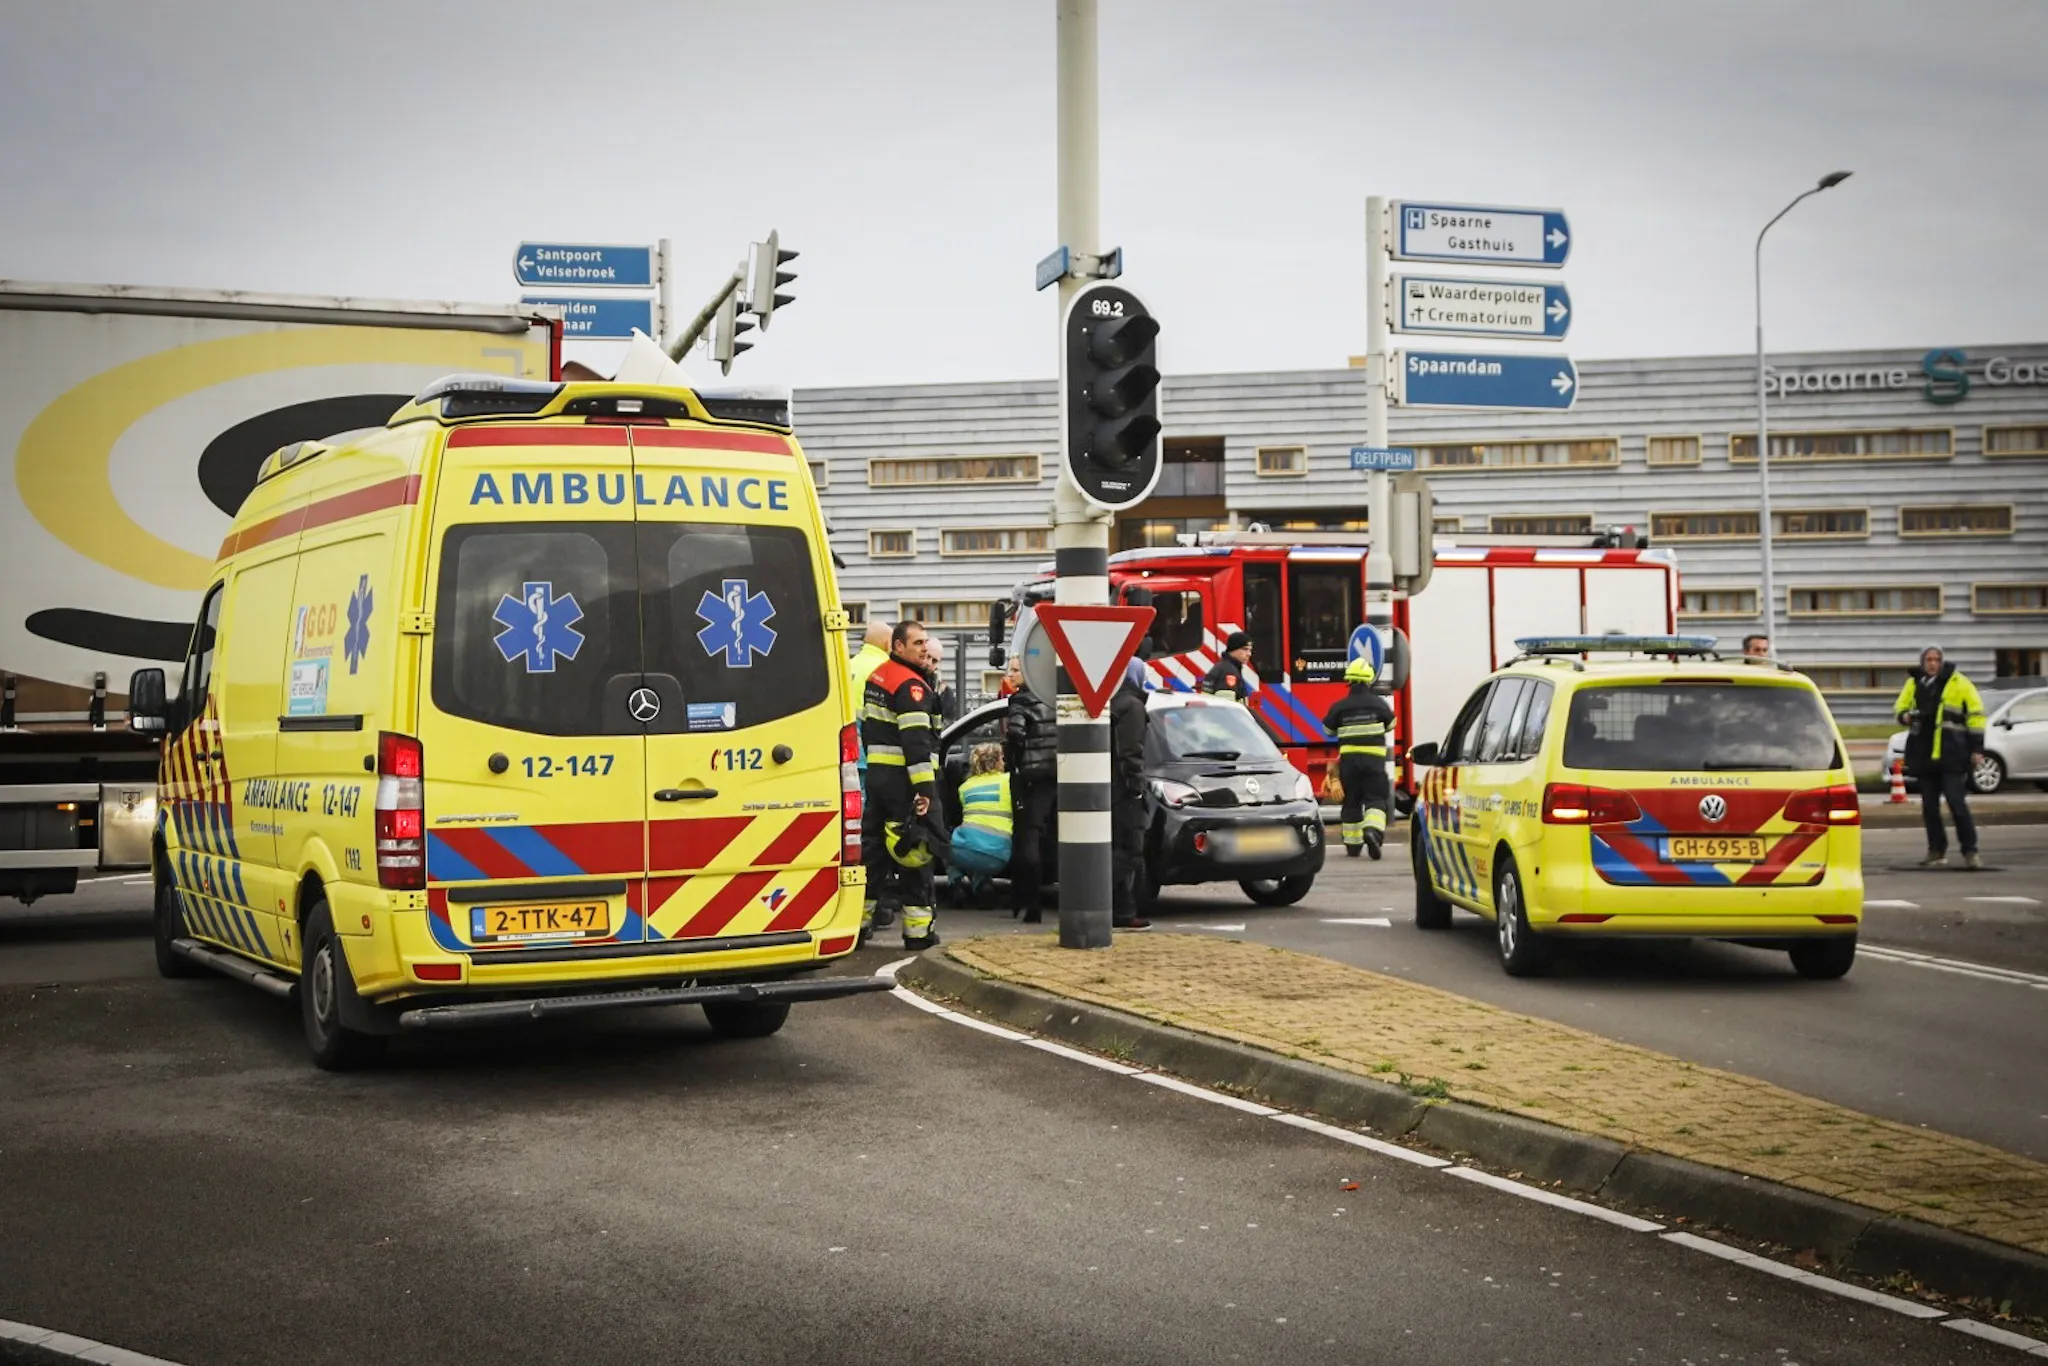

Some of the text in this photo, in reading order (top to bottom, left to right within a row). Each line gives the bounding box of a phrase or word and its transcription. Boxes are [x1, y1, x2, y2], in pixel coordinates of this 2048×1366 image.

[1431, 213, 1492, 232] Spaarne
[1448, 235, 1515, 252] Gasthuis
[536, 248, 602, 263] Santpoort
[536, 266, 616, 279] Velserbroek
[1429, 286, 1542, 305] Waarderpolder
[1092, 299, 1124, 317] 69.2
[1428, 308, 1533, 326] Crematorium
[1409, 357, 1502, 375] Spaarndam
[1764, 366, 1908, 399] Spaarne
[1355, 452, 1412, 466] DELFTPLEIN
[470, 472, 790, 511] AMBULANCE
[307, 604, 337, 638] GGD
[1307, 661, 1350, 669] BRANDWE
[521, 755, 615, 778] 12-147
[1670, 777, 1752, 786] AMBULANCE
[244, 779, 361, 817] AMBULANCE 12-147
[1673, 840, 1760, 856] GH-695-B
[474, 924, 484, 932] NL
[495, 907, 597, 931] 2-TTK-47
